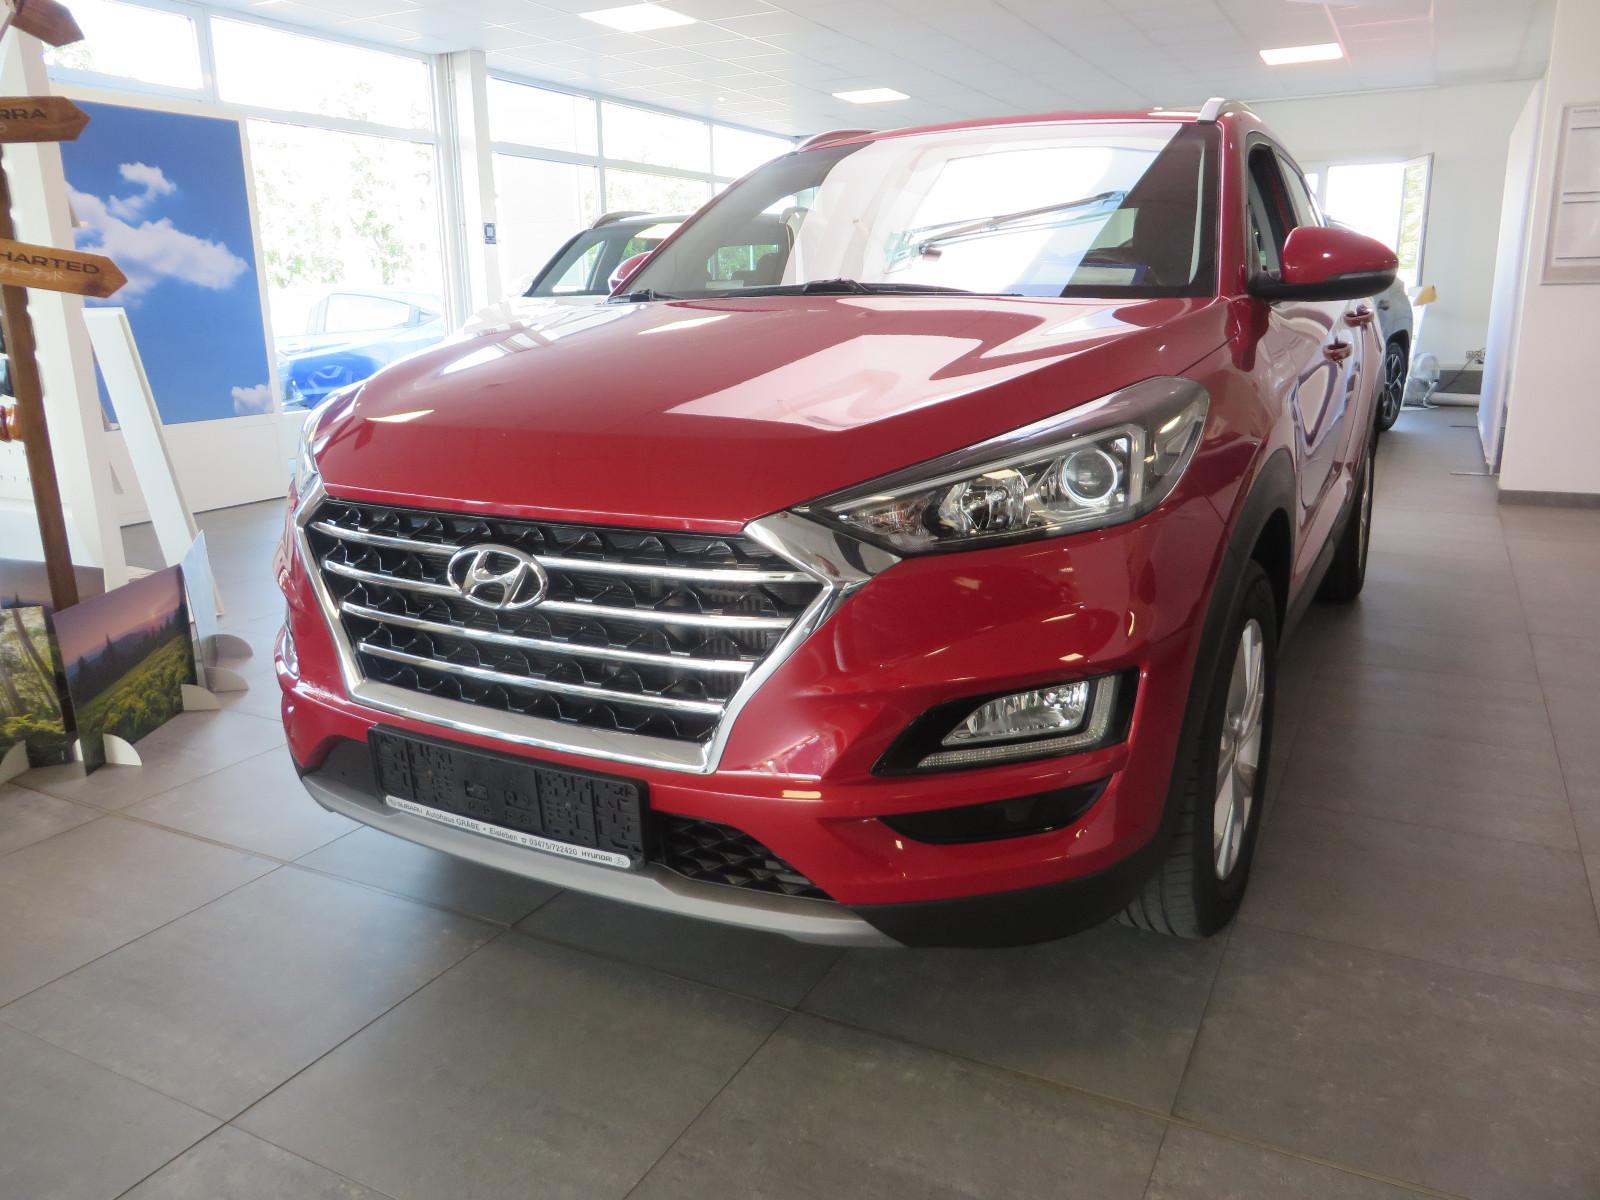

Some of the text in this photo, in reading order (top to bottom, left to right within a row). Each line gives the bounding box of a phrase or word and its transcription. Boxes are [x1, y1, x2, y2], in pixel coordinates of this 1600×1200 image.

[425, 810, 455, 824] Autohaus
[489, 827, 518, 841] Eisleben
[529, 839, 578, 856] 03475/722420
